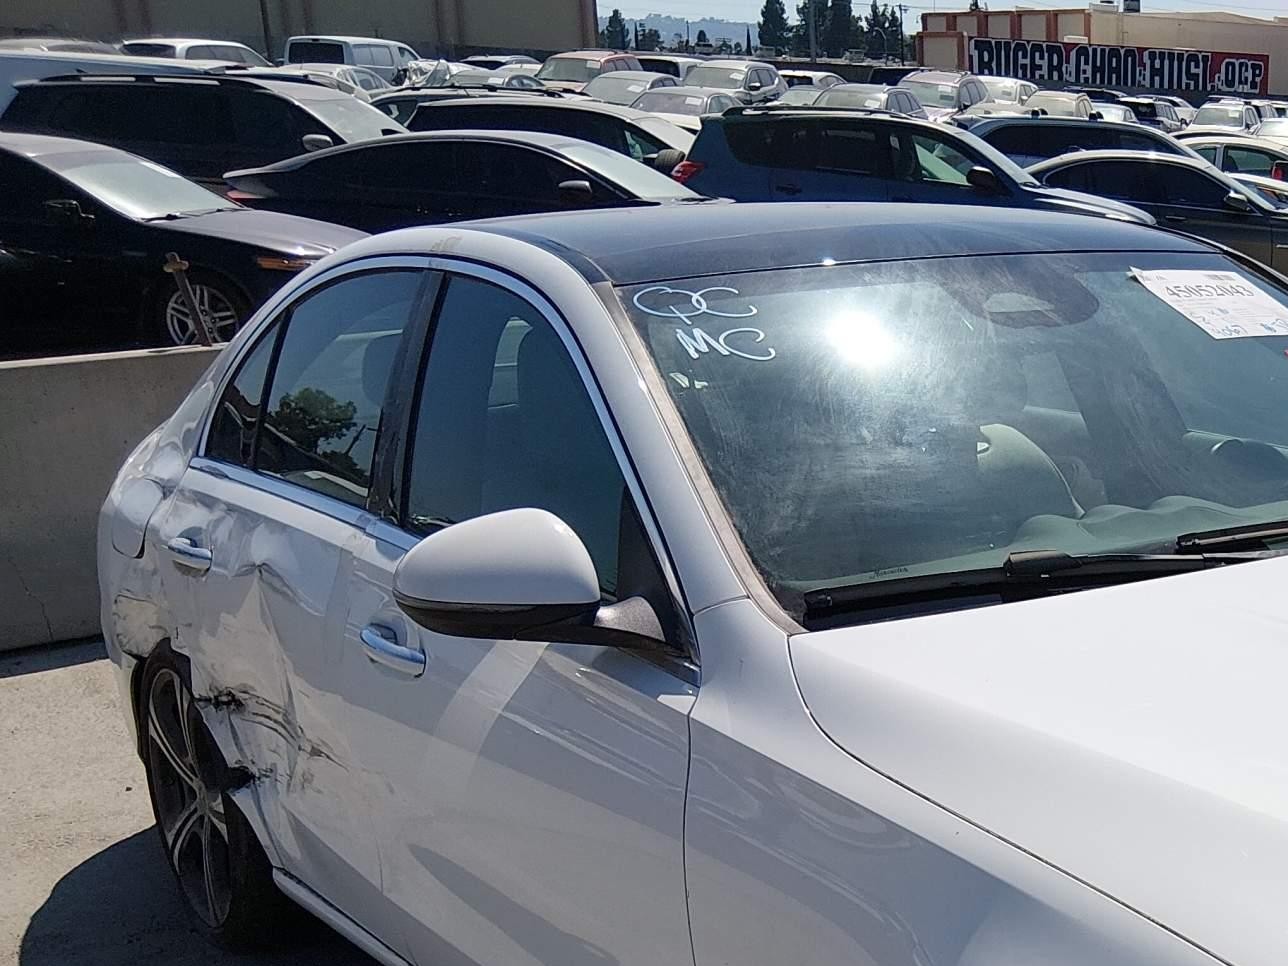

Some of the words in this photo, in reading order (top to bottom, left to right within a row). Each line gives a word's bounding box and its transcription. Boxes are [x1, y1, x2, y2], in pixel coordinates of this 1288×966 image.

[632, 286, 758, 325] QC
[1165, 284, 1255, 299] 45052043
[675, 327, 776, 361] MC
